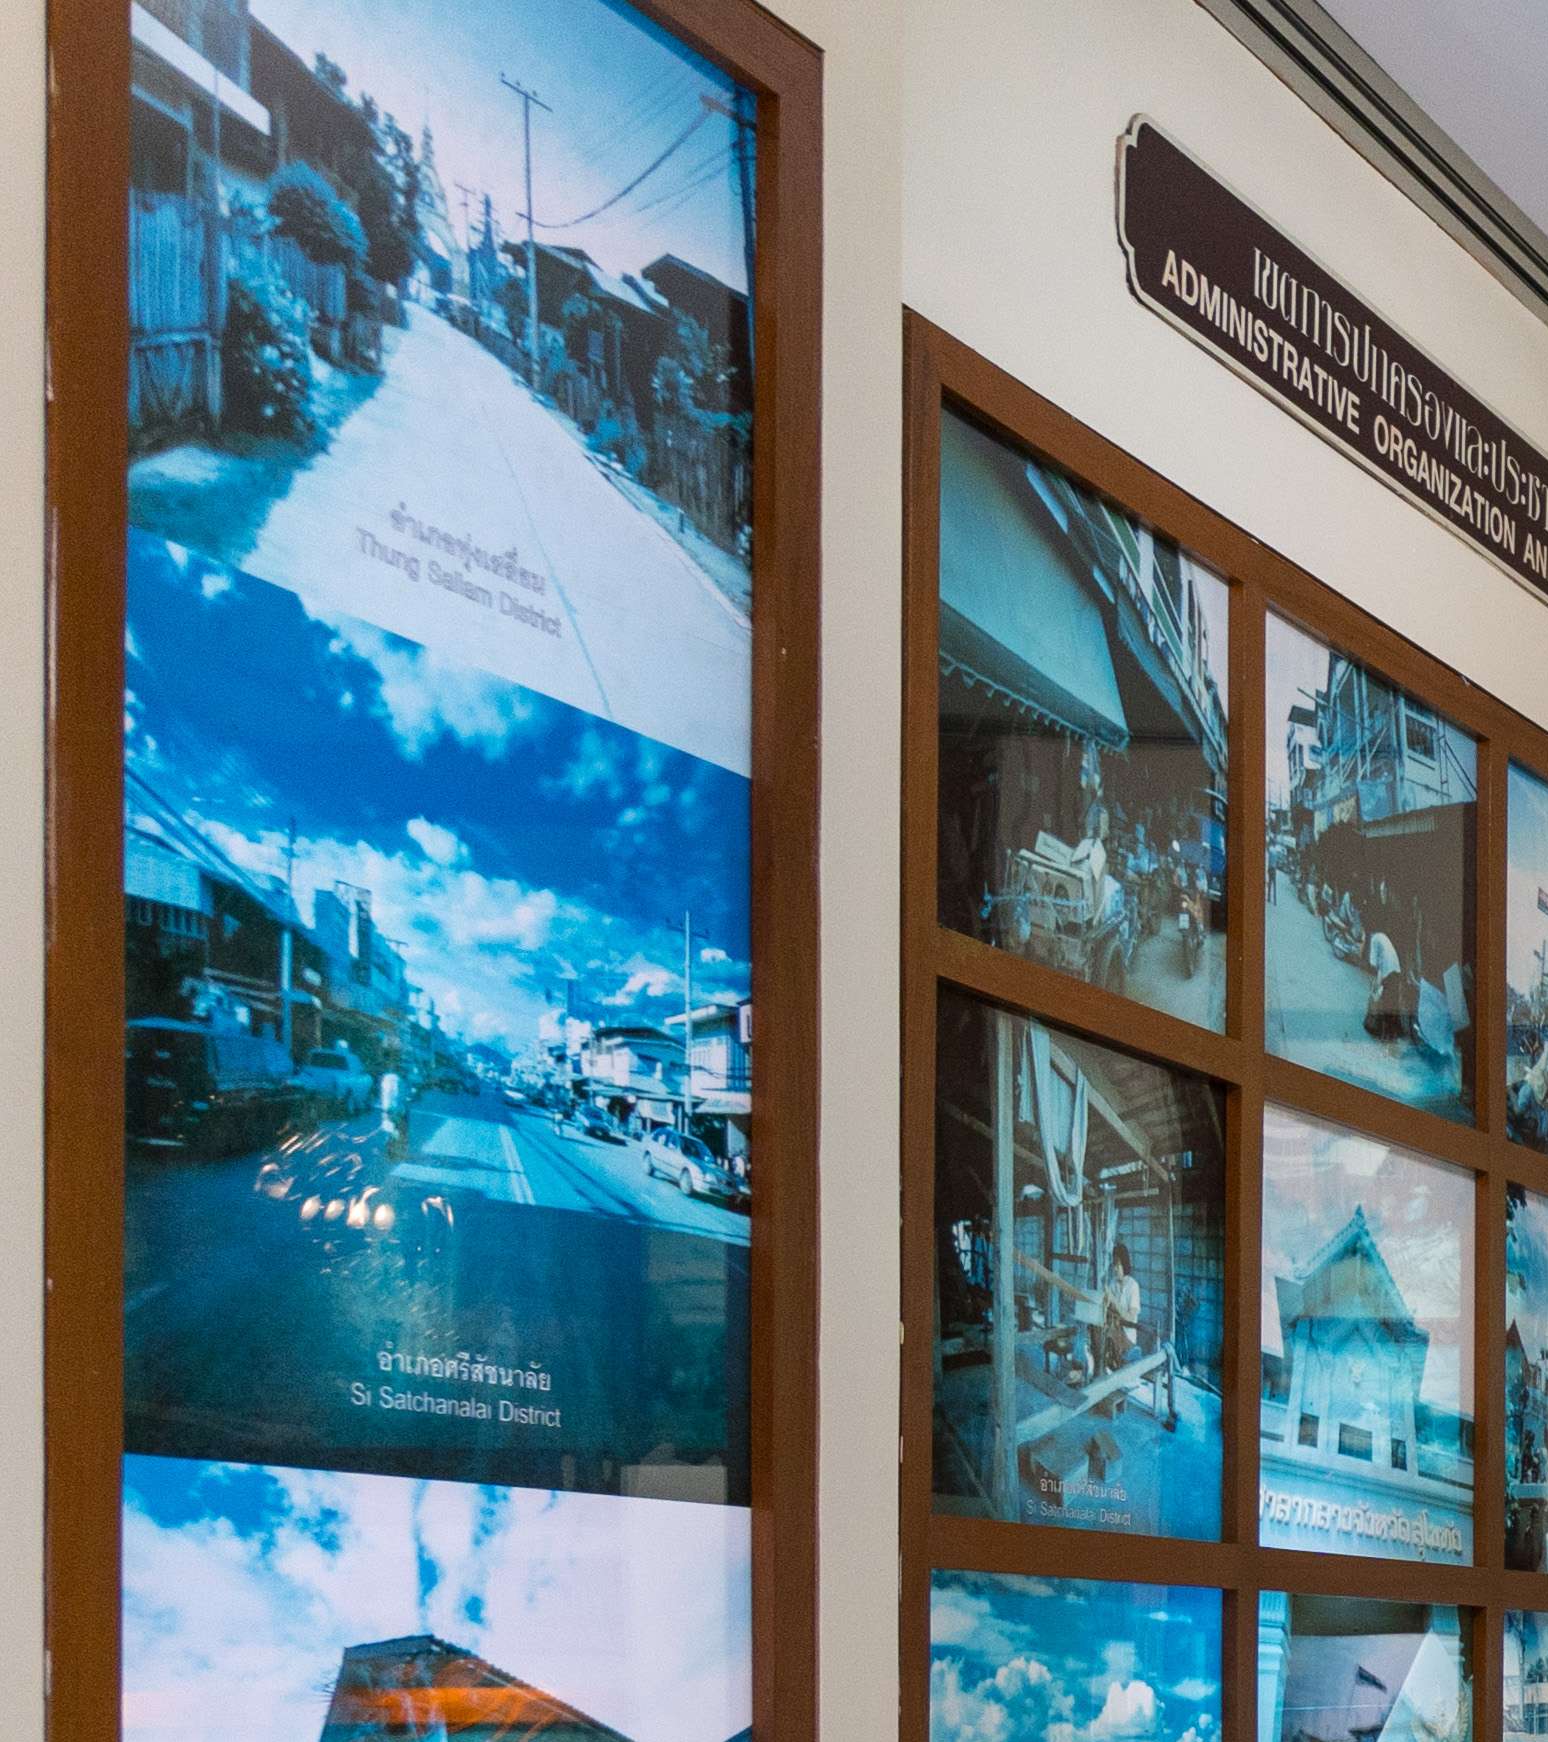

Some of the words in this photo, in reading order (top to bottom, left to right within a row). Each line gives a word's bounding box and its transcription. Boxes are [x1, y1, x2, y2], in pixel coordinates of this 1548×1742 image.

[1161, 249, 1360, 434] ADMINISTRATIVE
[1374, 415, 1516, 555] ORGANIZATION
[356, 526, 420, 583] Thung
[351, 1382, 371, 1407] Si
[379, 1386, 492, 1420] Satchanalai
[499, 1400, 562, 1429] District
